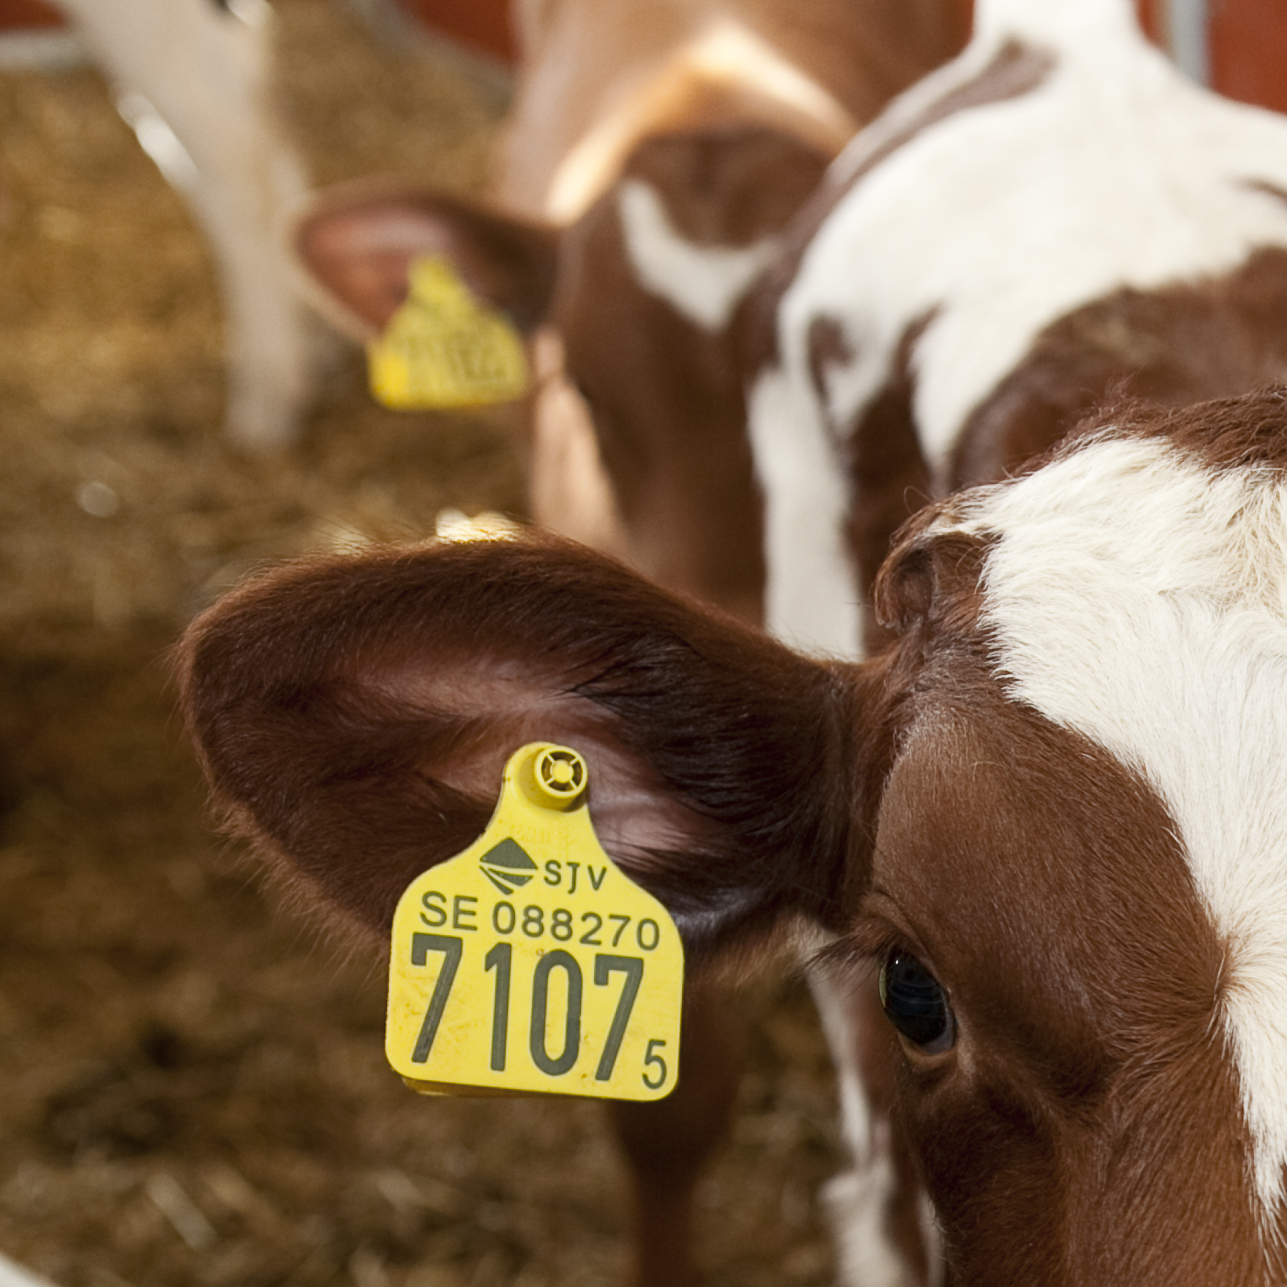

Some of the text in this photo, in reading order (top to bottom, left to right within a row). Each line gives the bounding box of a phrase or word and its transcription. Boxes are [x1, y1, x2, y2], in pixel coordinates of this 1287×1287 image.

[543, 860, 607, 894] SJV
[420, 891, 660, 951] SE 088270
